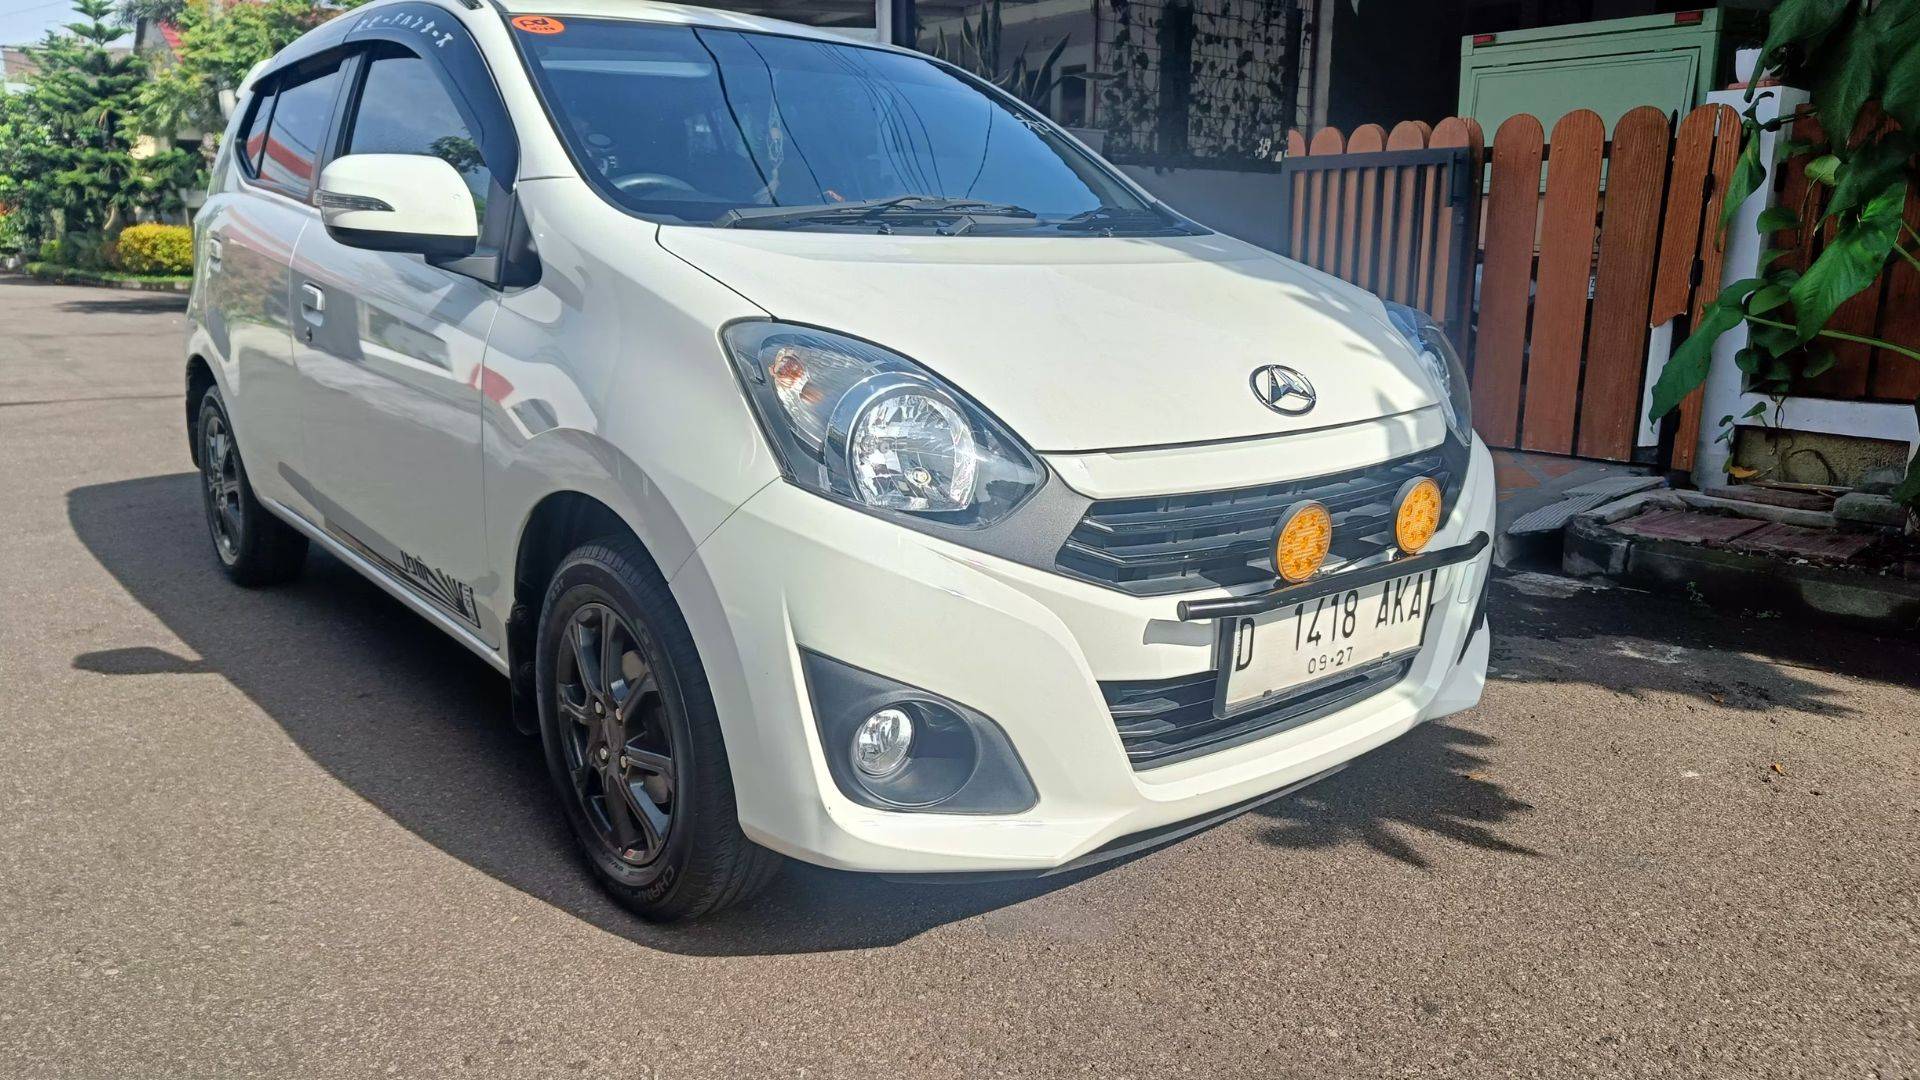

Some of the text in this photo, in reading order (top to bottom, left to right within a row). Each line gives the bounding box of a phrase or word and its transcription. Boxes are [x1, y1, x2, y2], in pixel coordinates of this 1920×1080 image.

[1235, 573, 1424, 672] D 1418 AKA
